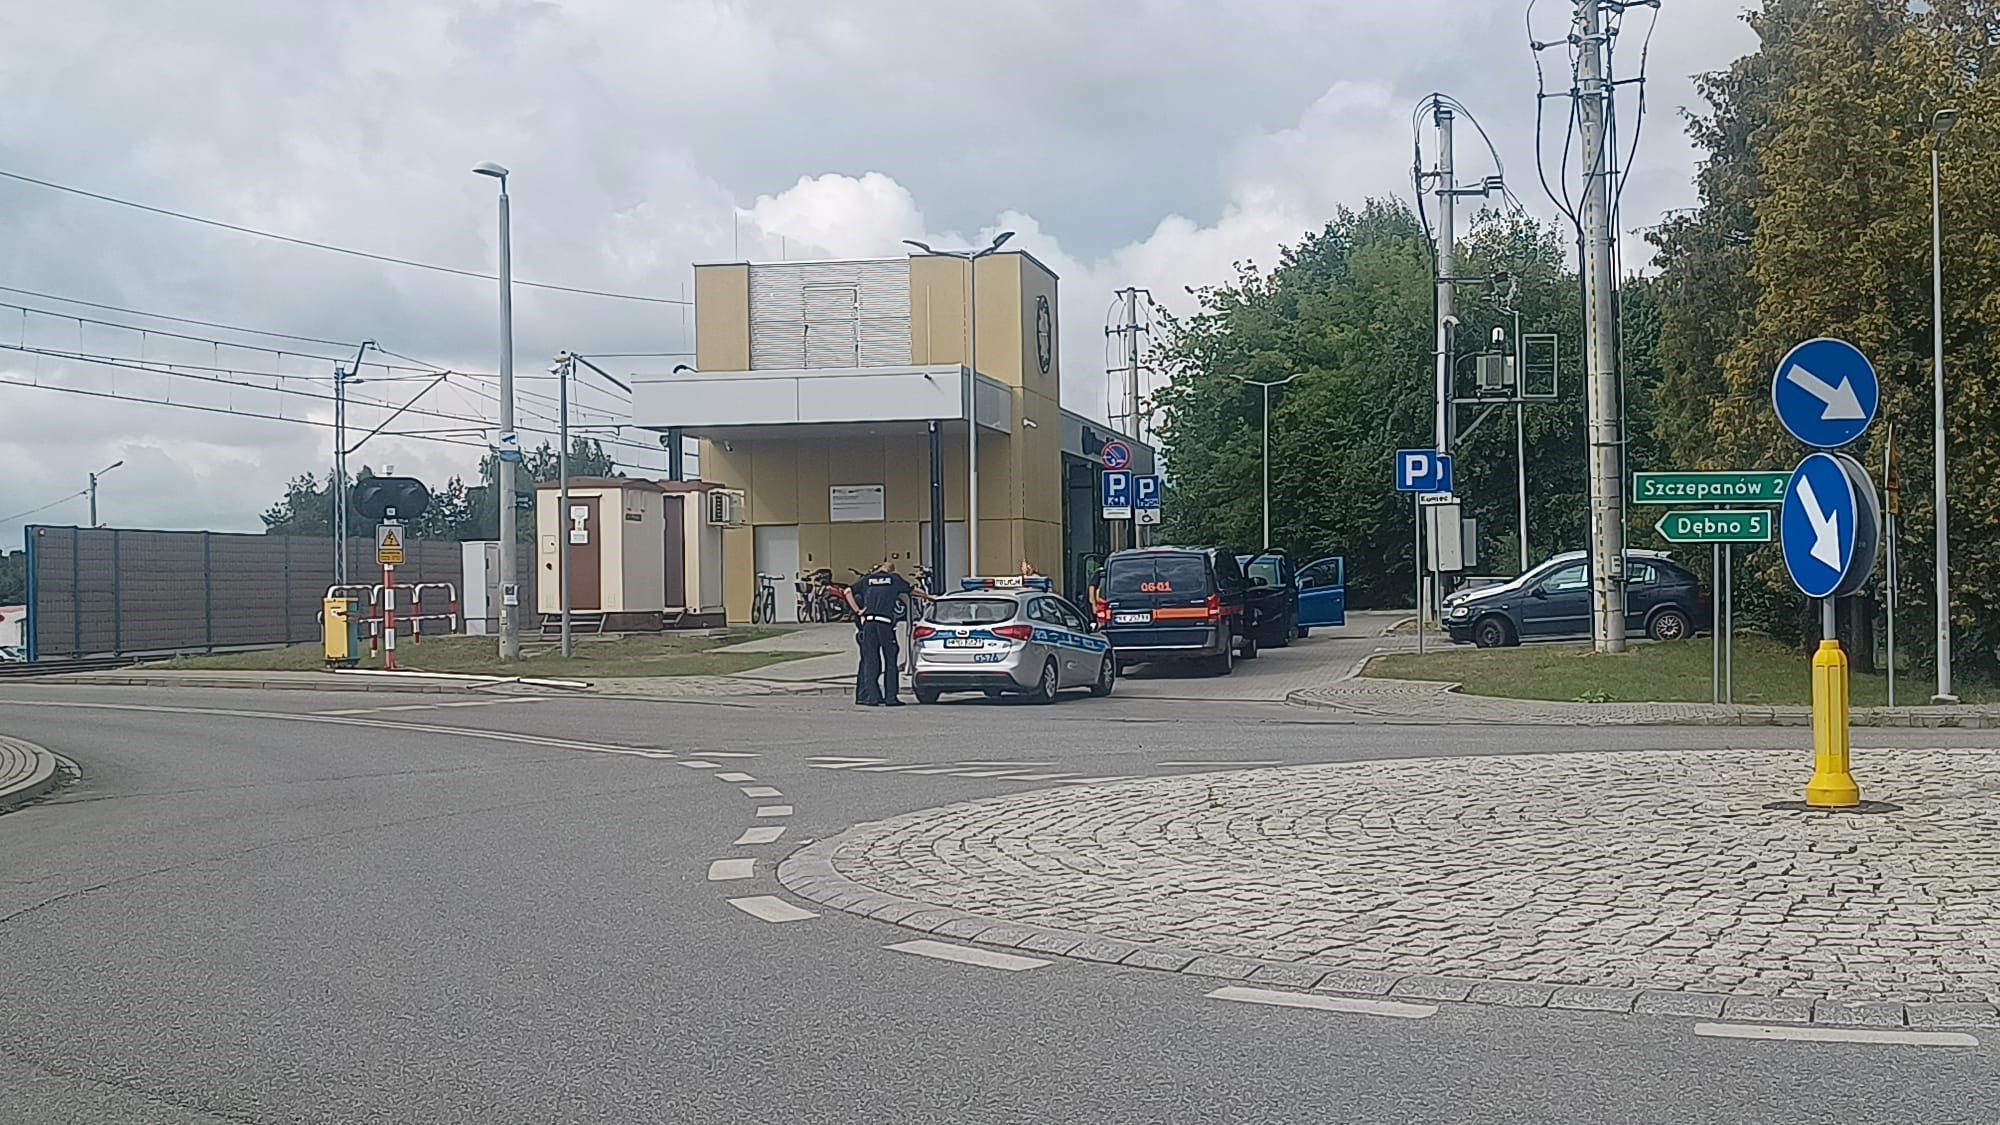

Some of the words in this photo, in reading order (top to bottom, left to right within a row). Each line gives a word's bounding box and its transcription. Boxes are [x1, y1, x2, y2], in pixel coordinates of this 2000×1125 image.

[1405, 454, 1429, 486] P
[1109, 473, 1126, 496] P
[1139, 478, 1155, 499] P
[1644, 478, 1762, 499] Szczepanów
[1773, 478, 1784, 494] 2
[1677, 517, 1741, 538] Dębno
[1749, 516, 1761, 532] 5
